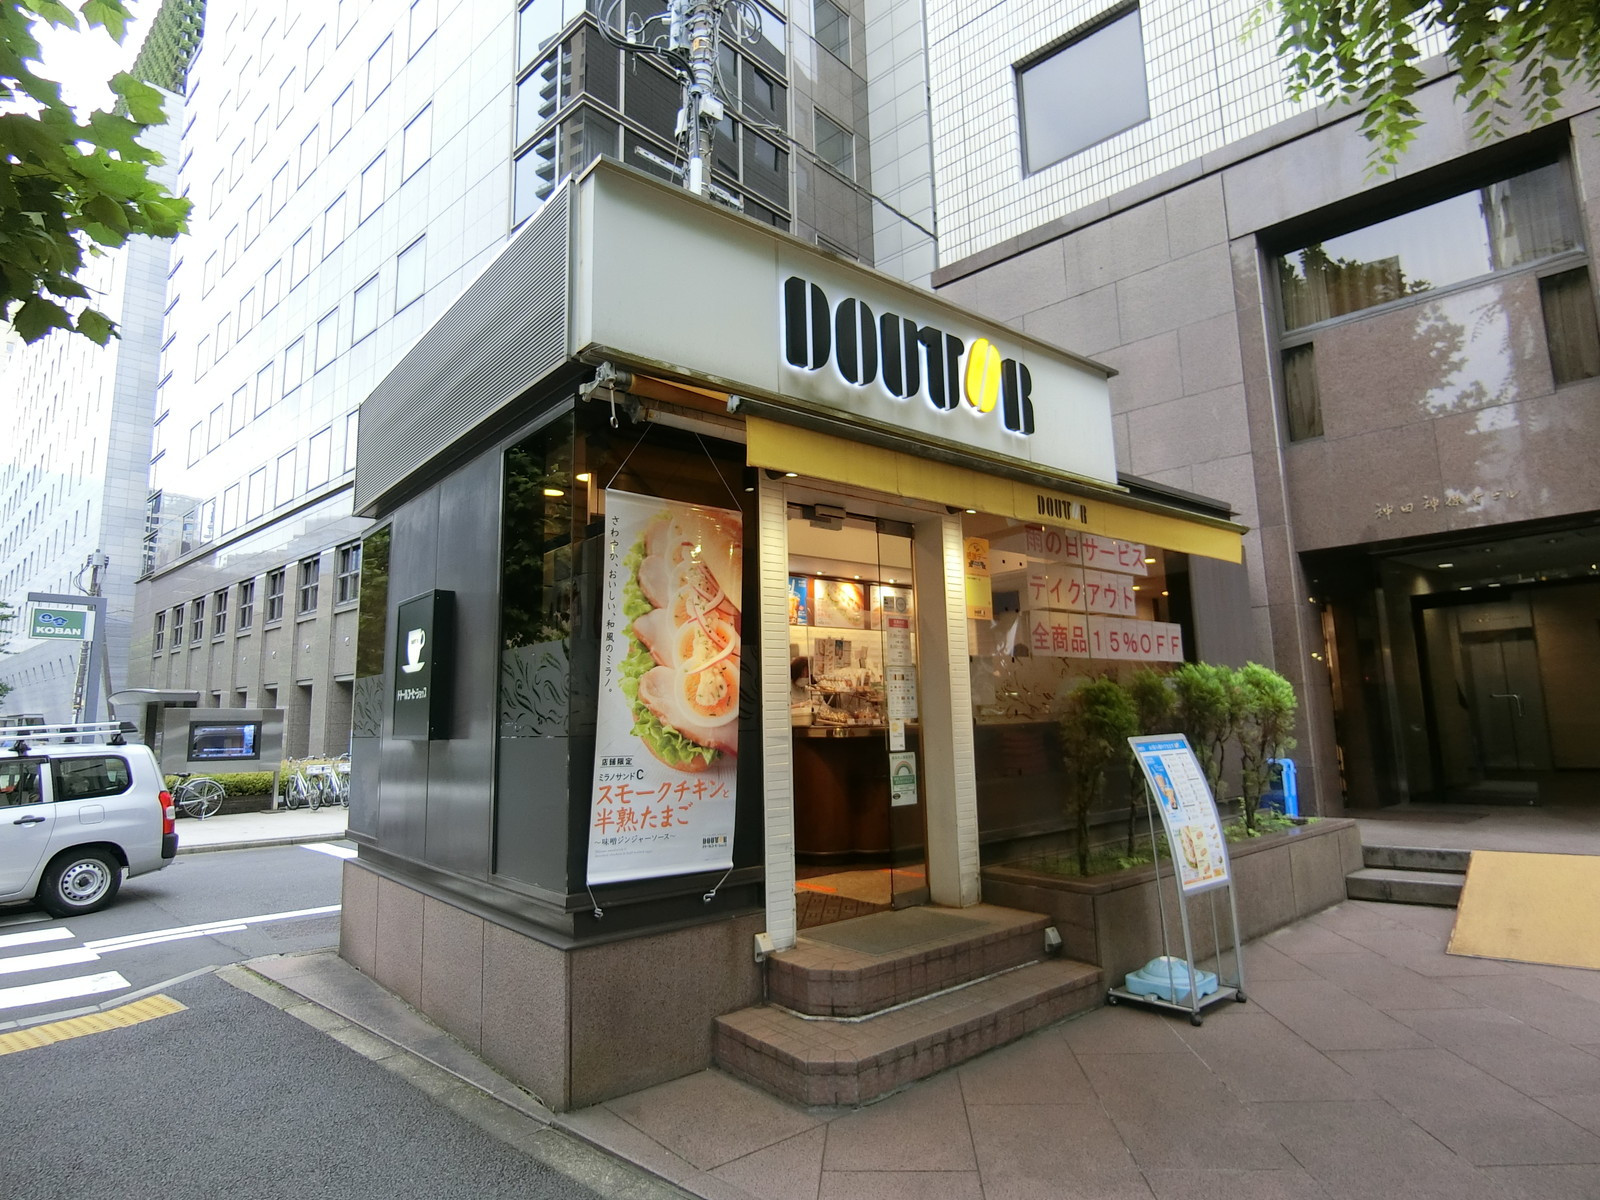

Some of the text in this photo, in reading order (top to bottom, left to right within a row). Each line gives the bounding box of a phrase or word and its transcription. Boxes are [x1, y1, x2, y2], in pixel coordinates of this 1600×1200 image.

[784, 276, 1035, 435] DOUTOR
[1025, 528, 1145, 568] 雨の日サービス
[604, 515, 620, 693] さわやか、おいしい、和風のミラノ。
[1029, 575, 1134, 610] テイクアウト
[36, 626, 81, 636] KOBAN
[1031, 621, 1180, 656] 全商品15%OFF
[601, 757, 633, 766] 店舗限定
[596, 778, 729, 805] スモークチキンと
[594, 802, 693, 835] 半熟たまご
